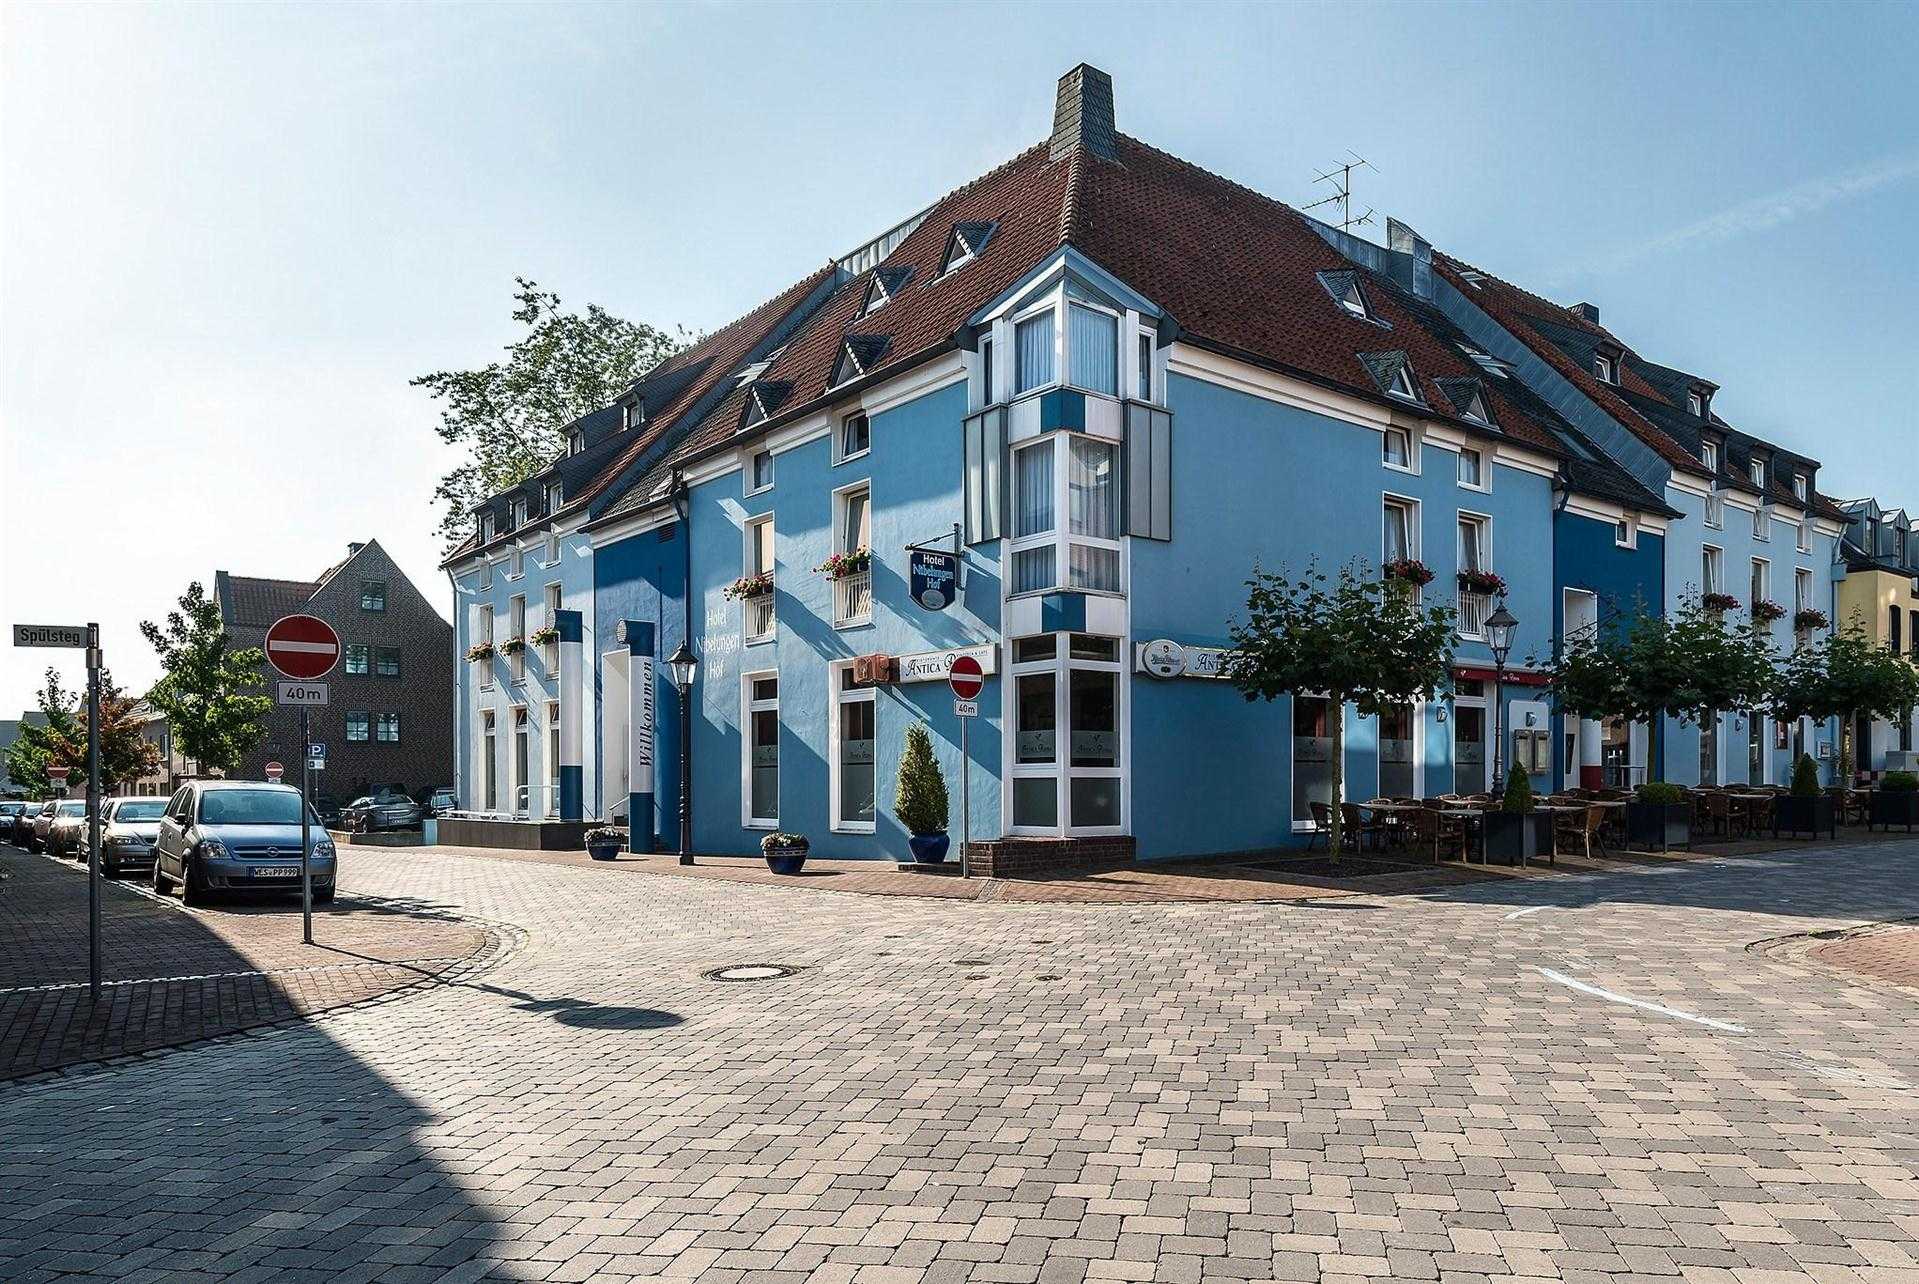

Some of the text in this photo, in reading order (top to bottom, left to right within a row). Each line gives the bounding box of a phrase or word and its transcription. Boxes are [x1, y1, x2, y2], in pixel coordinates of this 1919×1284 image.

[923, 554, 945, 566] Hotel
[926, 577, 941, 590] Hof
[706, 608, 727, 627] Hotel
[20, 628, 80, 646] Spülsteg
[695, 633, 740, 654] Nibelungen
[709, 659, 726, 679] Hof
[640, 661, 653, 767] Willkommen
